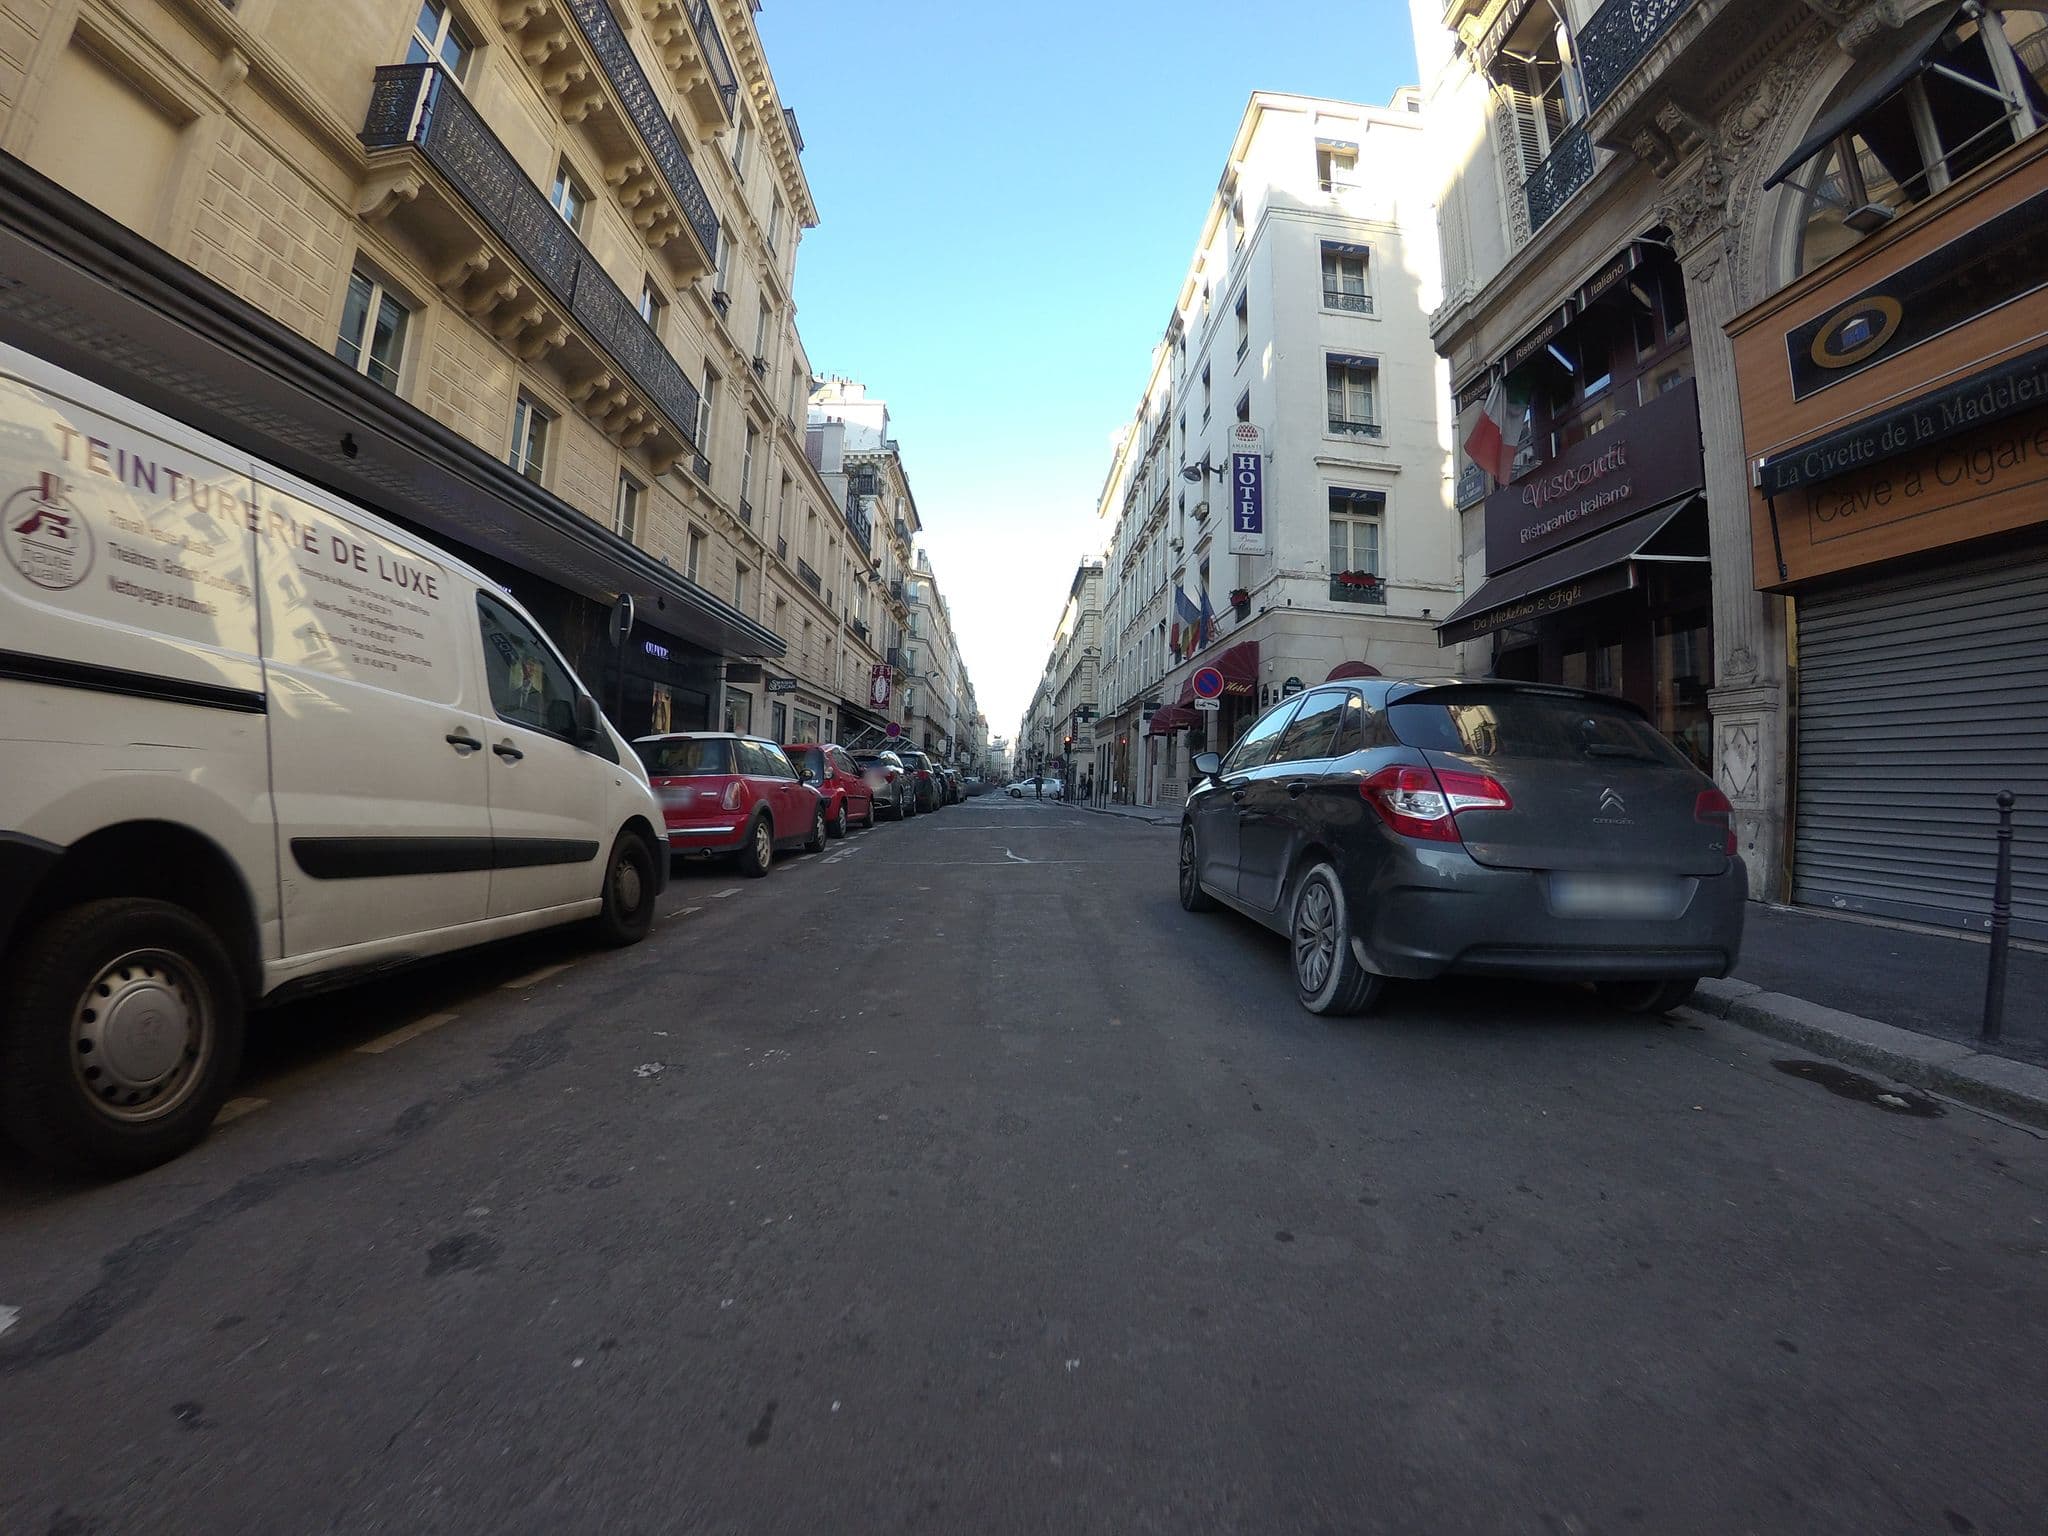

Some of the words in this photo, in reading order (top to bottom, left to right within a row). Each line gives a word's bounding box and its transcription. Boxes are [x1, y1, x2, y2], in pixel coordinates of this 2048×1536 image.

[1590, 263, 1624, 297] Italiano
[1515, 324, 1554, 361] Ristorante
[1522, 439, 1627, 508] Visconti
[1775, 465, 1799, 488] La
[1804, 436, 1875, 477] Civette
[1881, 422, 1907, 451] de
[1912, 413, 1935, 441] la
[54, 423, 320, 554] TEINTURERIE
[331, 535, 369, 573] DE
[378, 555, 440, 600] LUXE
[1238, 456, 1256, 530] HOTEL
[1520, 508, 1578, 544] Ristorante
[1580, 483, 1631, 516] Italiano
[1815, 477, 1893, 523] Cave
[1472, 618, 1487, 631] Da
